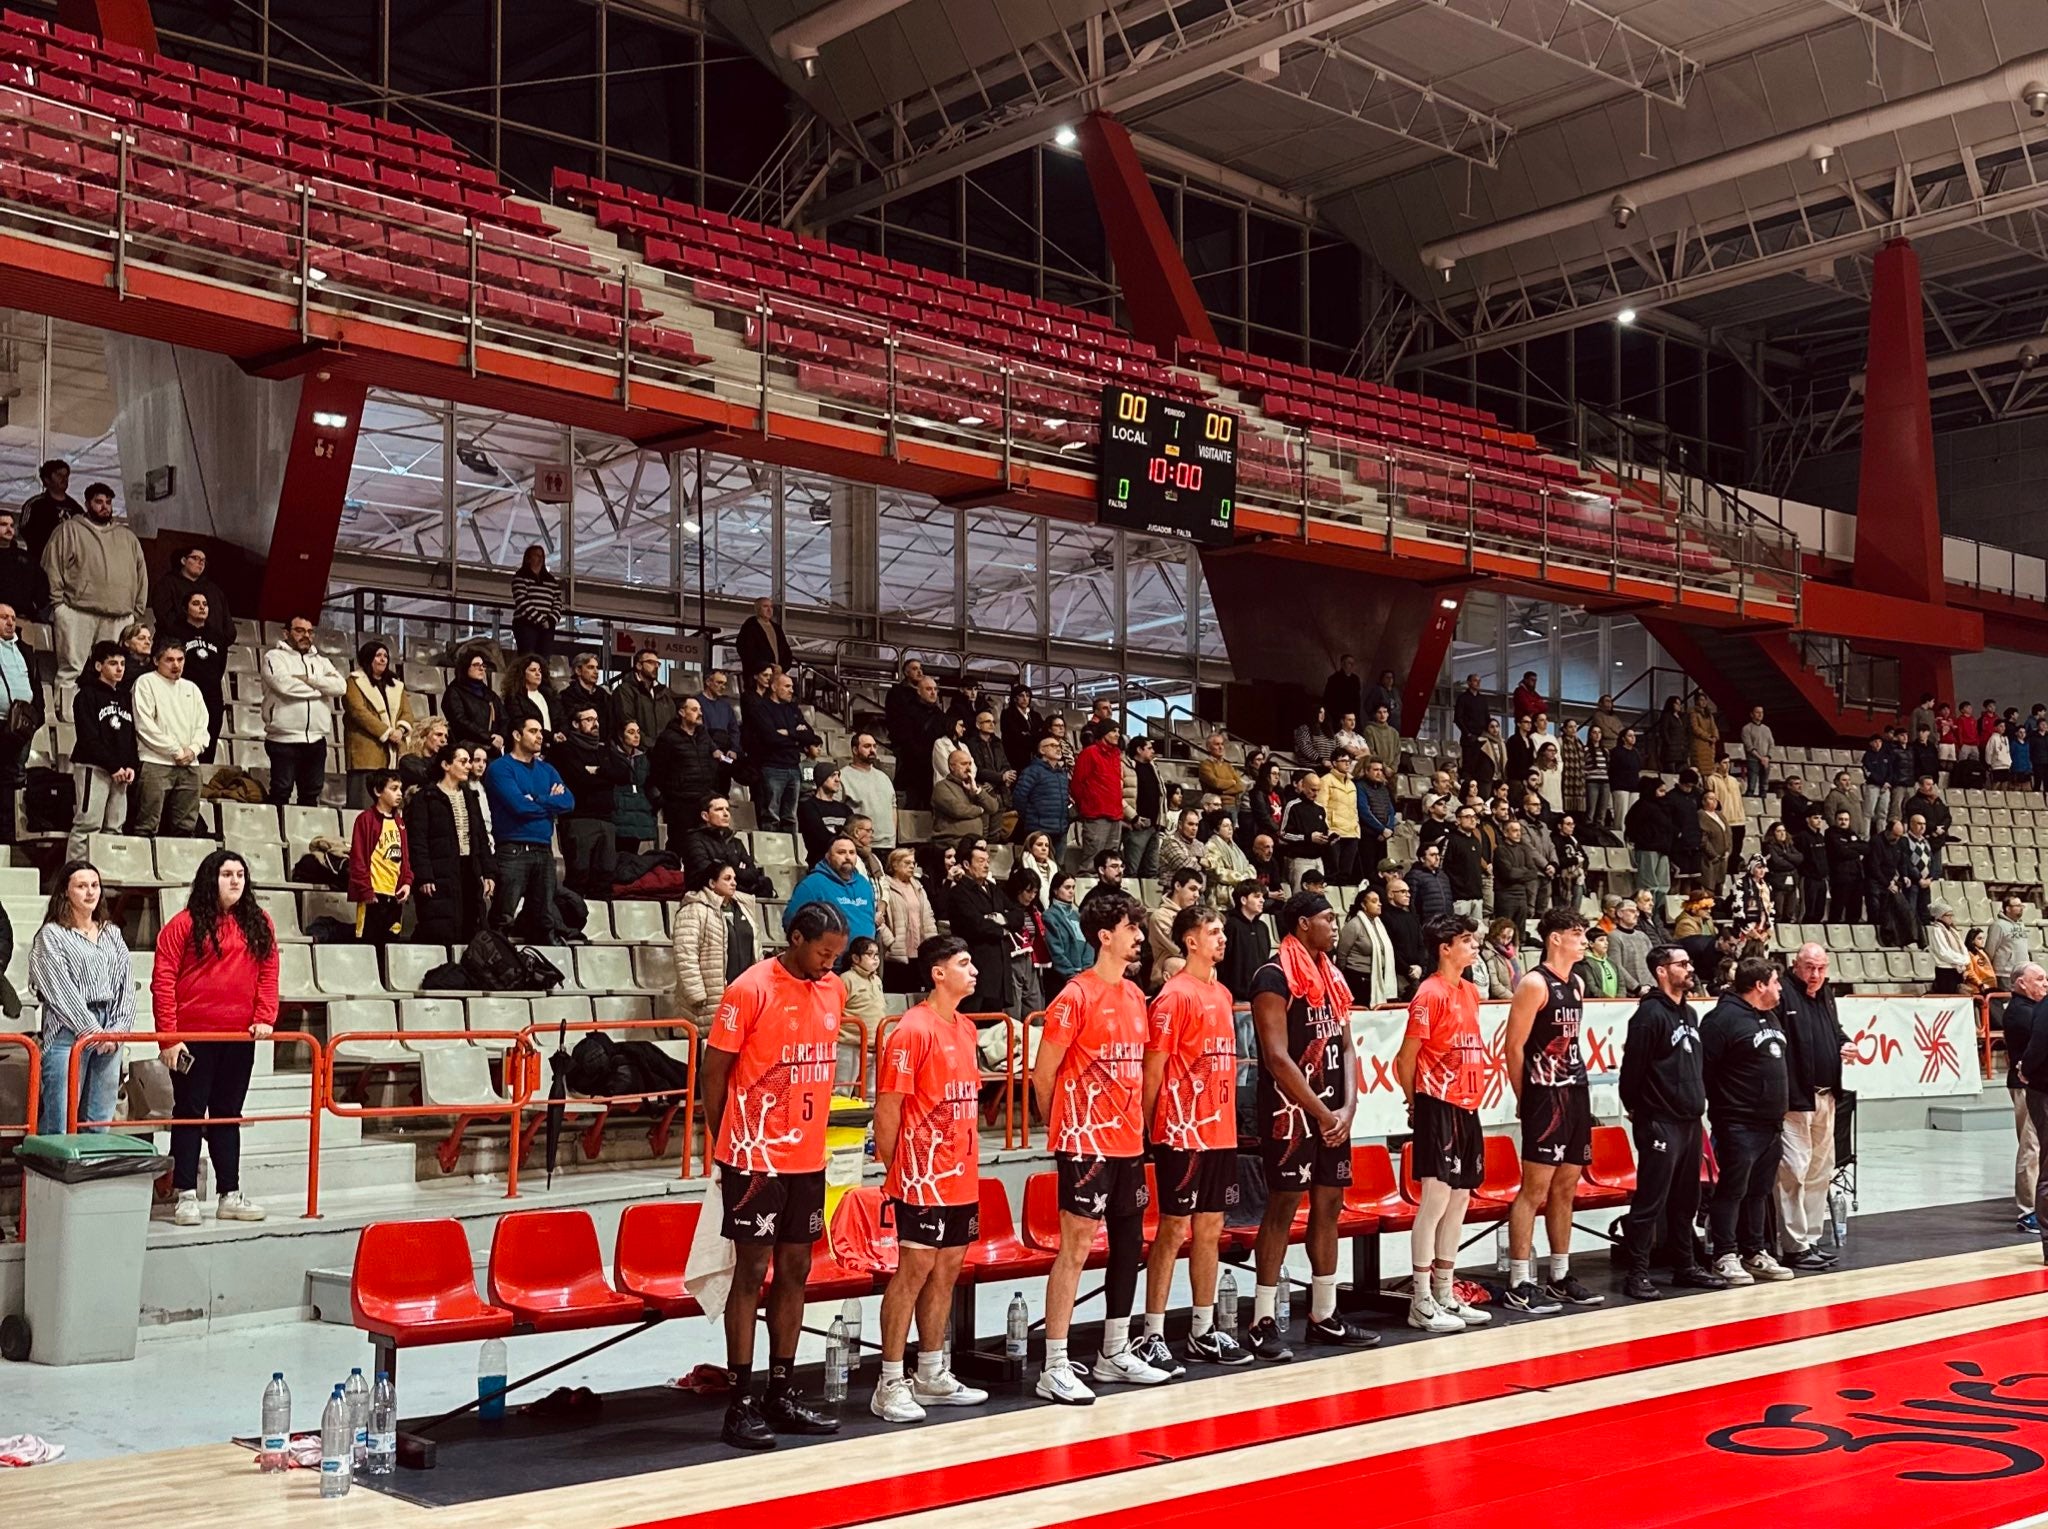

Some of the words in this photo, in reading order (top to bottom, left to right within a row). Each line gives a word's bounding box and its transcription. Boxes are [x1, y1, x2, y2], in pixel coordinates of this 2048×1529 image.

[1119, 392, 1148, 424] 00
[1112, 425, 1148, 445] LOCAL
[1205, 413, 1233, 442] 00
[1198, 444, 1233, 464] VISITANTE
[1149, 457, 1203, 491] 10:00
[1118, 478, 1130, 500] 0
[1108, 498, 1128, 510] FALTAS
[1220, 498, 1231, 520] 0
[1146, 523, 1172, 536] JUGADOR
[1176, 528, 1192, 539] FALTA
[1210, 518, 1229, 529] FALTAS
[665, 642, 699, 655] ASEOS
[1325, 1044, 1340, 1070] 12
[802, 1092, 813, 1121] 5
